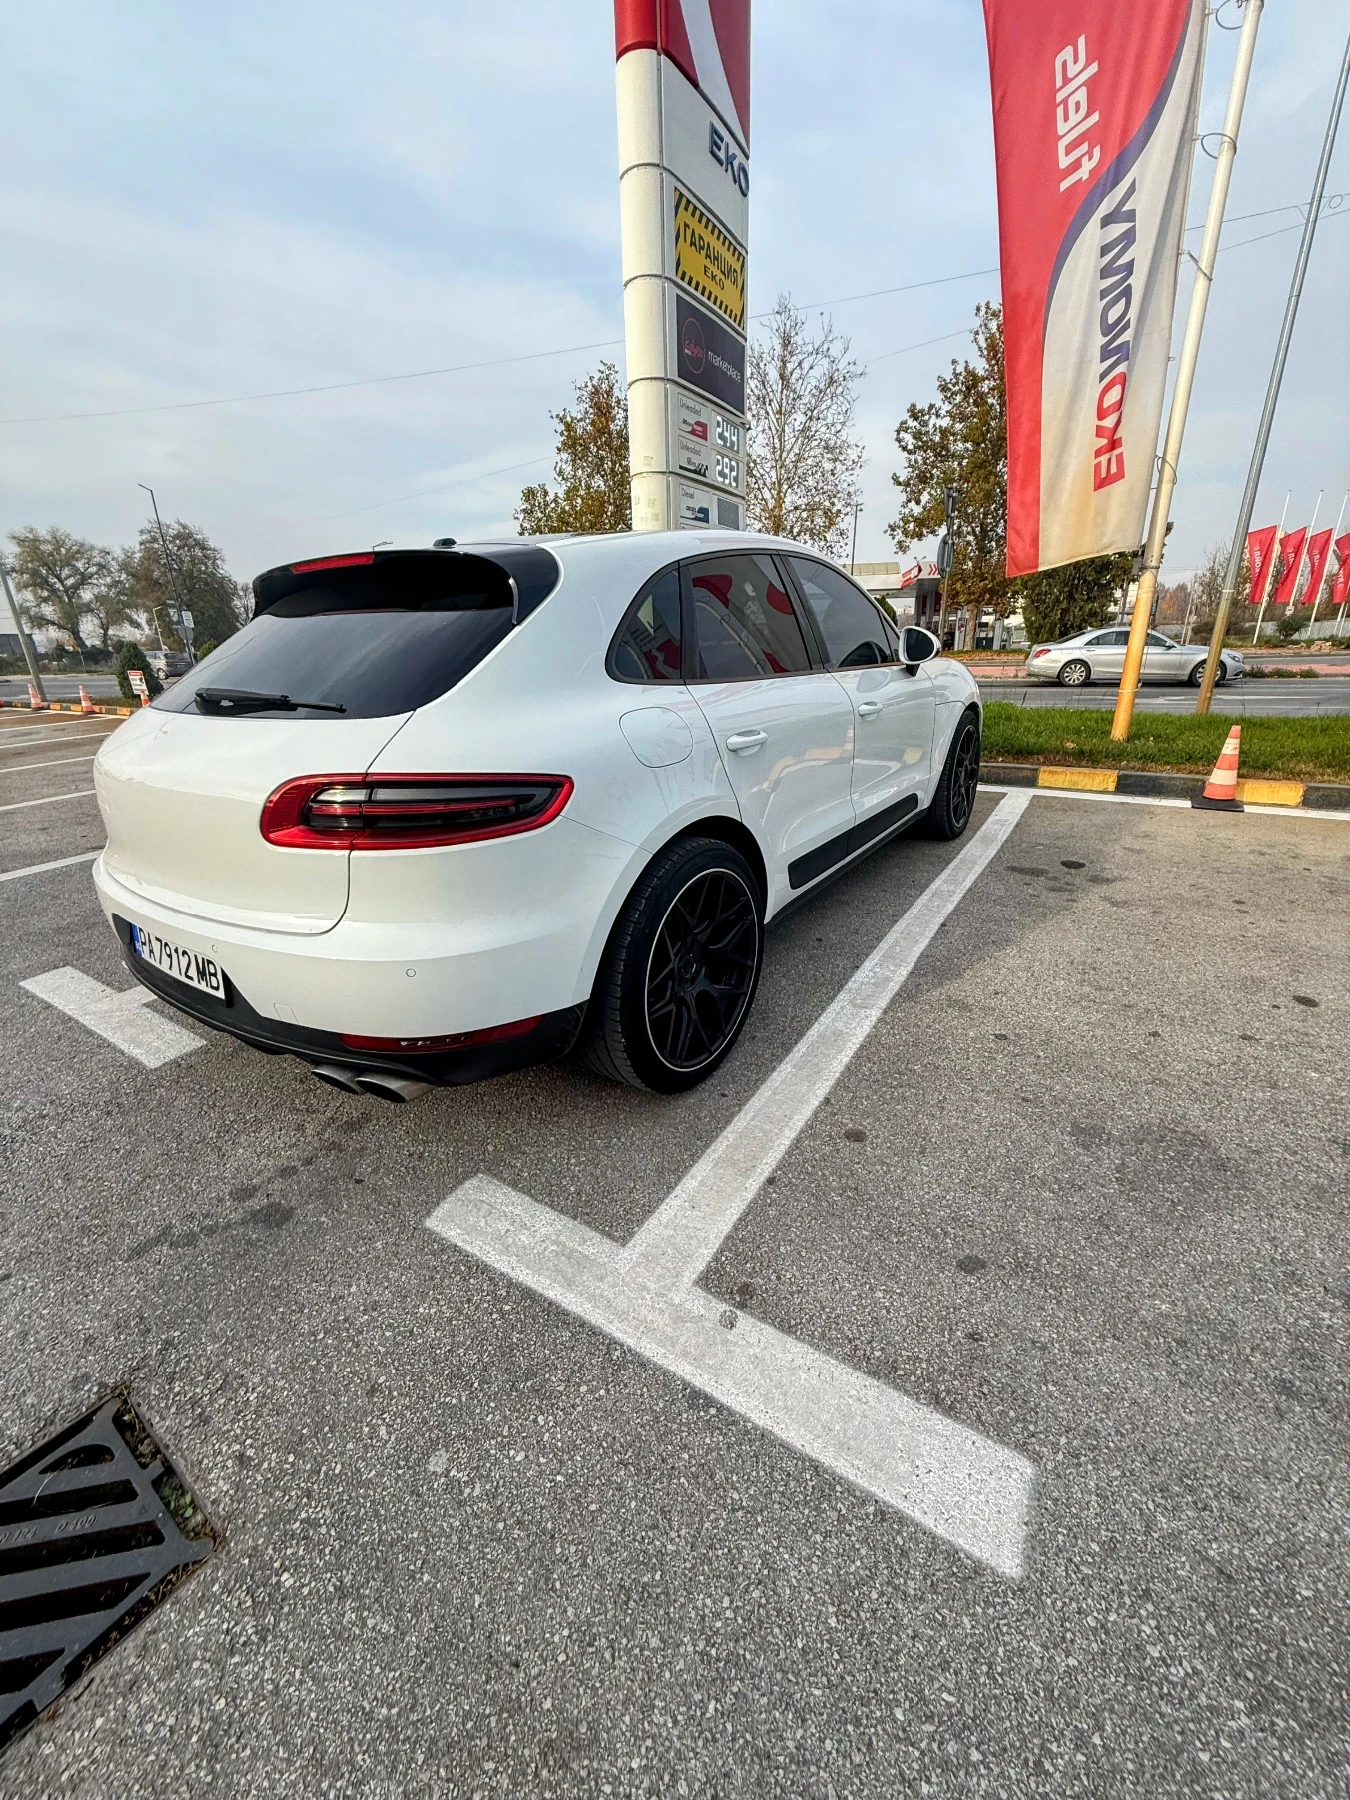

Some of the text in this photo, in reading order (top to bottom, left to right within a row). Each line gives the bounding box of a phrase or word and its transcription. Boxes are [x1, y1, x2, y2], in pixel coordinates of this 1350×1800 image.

[709, 120, 750, 197] EKO
[683, 219, 739, 289] ГАРАНЦИЯ
[703, 263, 725, 291] EKO
[707, 350, 742, 383] marketplace
[680, 397, 702, 417] Unleaded
[680, 440, 702, 457] Unleaded
[716, 415, 739, 451] 244
[716, 454, 738, 487] 292
[681, 487, 695, 500] Diesel
